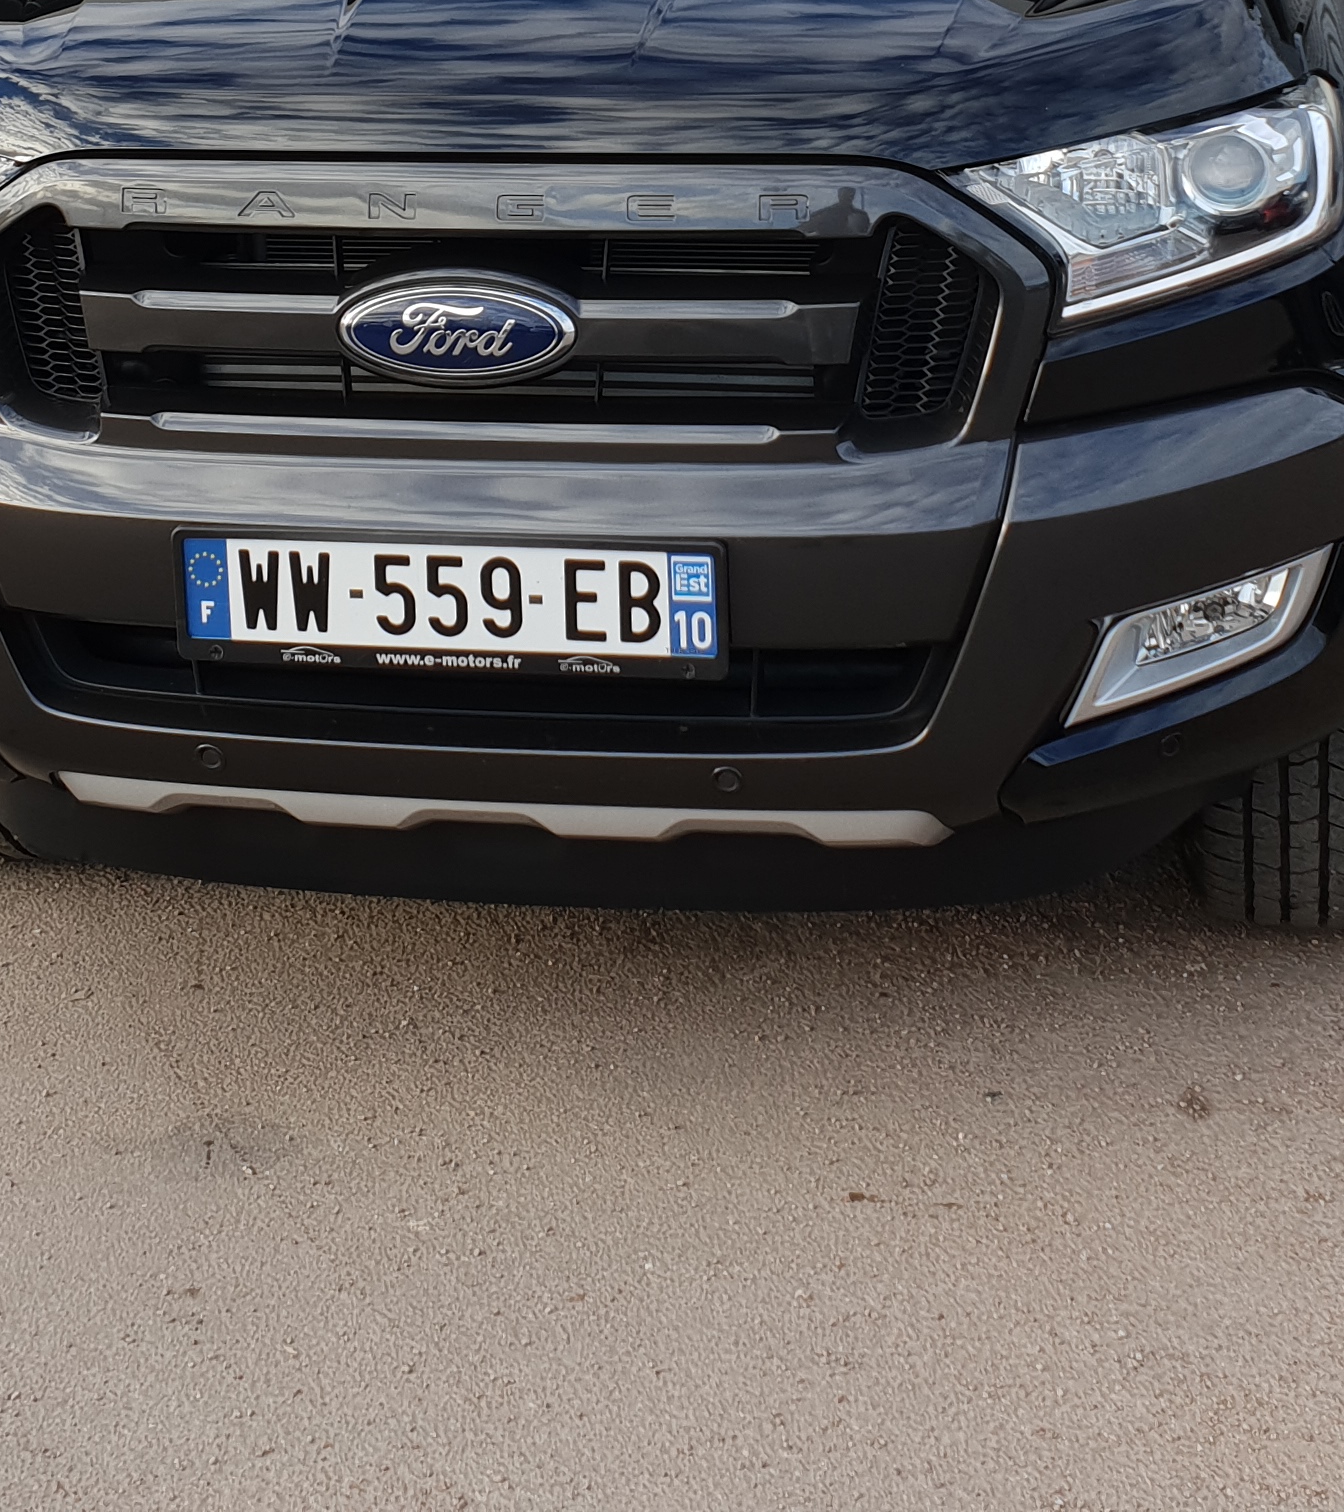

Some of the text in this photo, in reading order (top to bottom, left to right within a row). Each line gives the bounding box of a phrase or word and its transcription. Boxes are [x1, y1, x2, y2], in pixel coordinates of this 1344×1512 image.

[120, 186, 810, 223] RANGER
[389, 302, 516, 357] Ford
[675, 563, 708, 575] Grand
[675, 573, 708, 593] Est
[238, 548, 662, 643] WW-559-EB
[200, 600, 215, 624] F
[674, 610, 712, 650] 10
[376, 651, 522, 670] www.e-motors.fr
